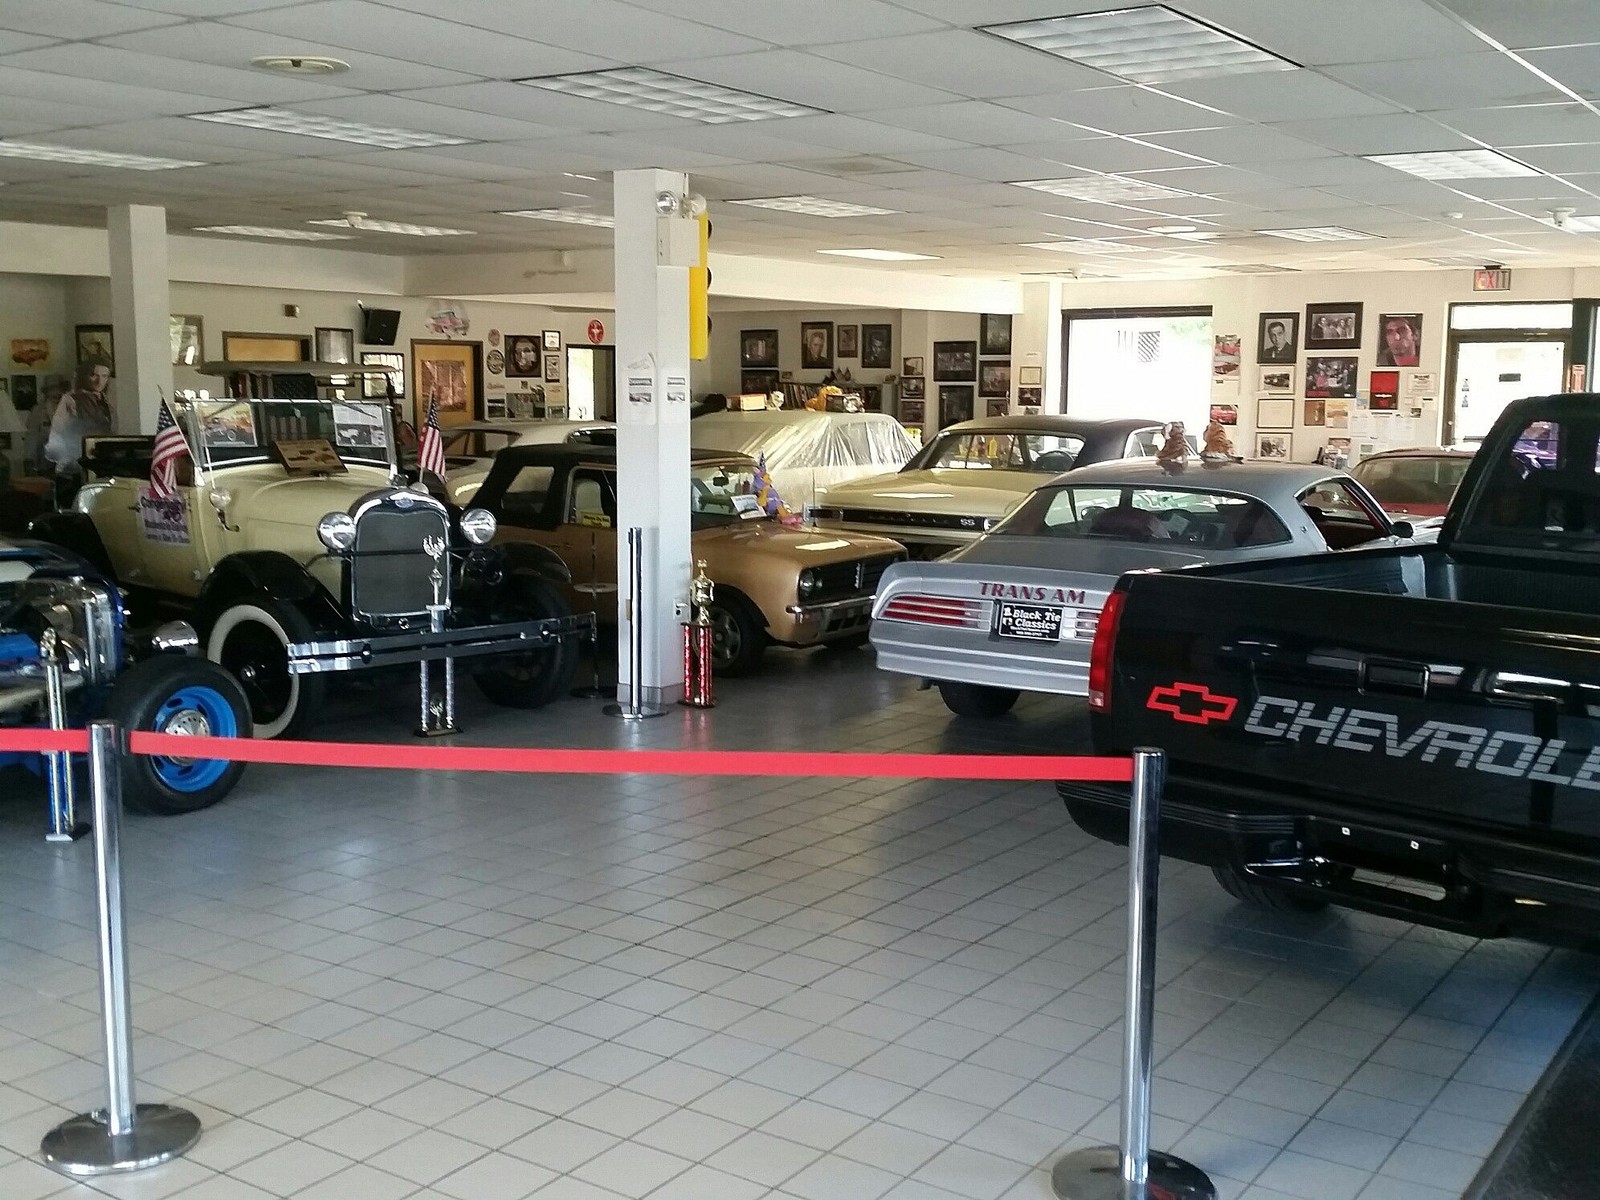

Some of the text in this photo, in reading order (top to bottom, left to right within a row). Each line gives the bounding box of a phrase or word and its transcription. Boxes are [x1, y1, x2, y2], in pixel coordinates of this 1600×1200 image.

[1476, 270, 1508, 289] EXIT
[960, 518, 976, 527] SS
[979, 582, 1086, 604] TRANS AM
[1013, 609, 1061, 622] Black Tie
[1015, 618, 1057, 630] Classics
